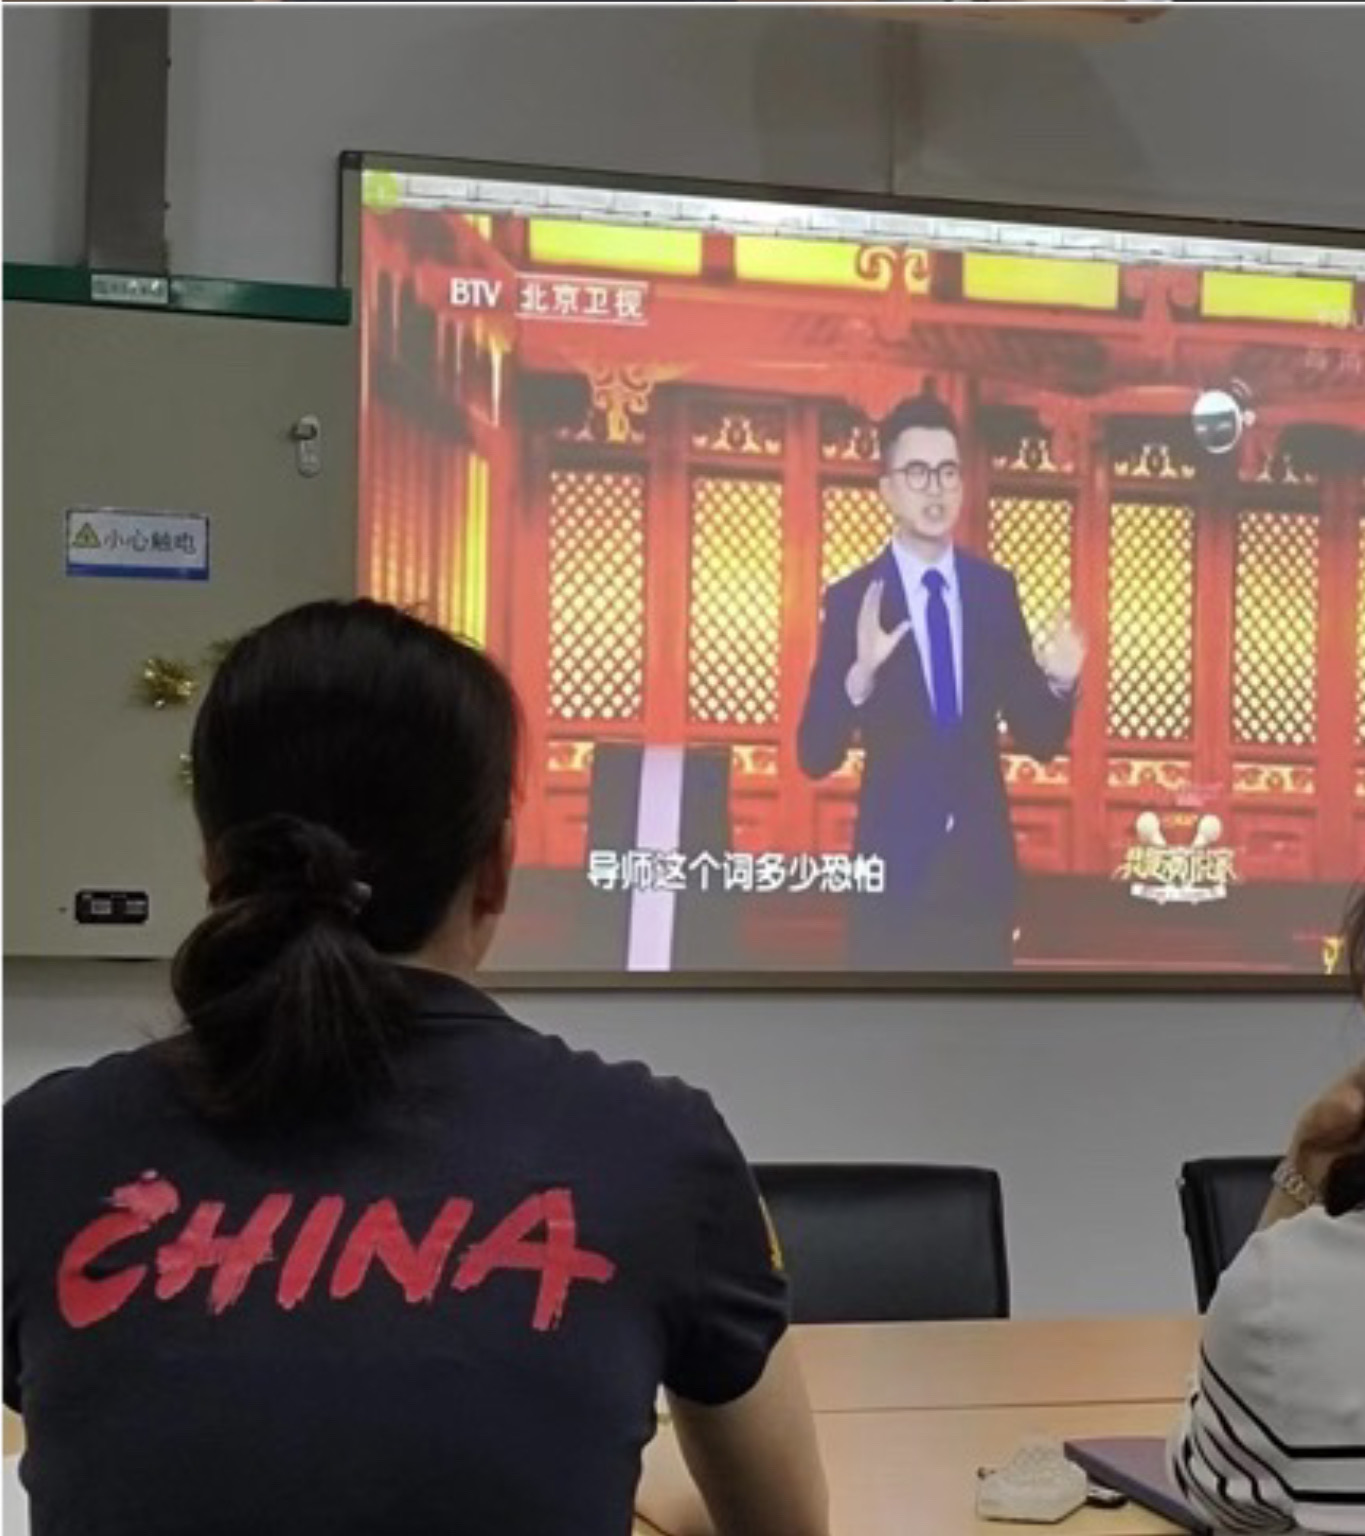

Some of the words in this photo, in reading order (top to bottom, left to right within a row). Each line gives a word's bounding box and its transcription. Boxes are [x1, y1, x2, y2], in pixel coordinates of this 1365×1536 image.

[451, 277, 503, 308] BTV
[519, 281, 644, 320] 北京卫视
[103, 528, 197, 556] 小心触电
[586, 849, 887, 894] 导师这个词多少恐怕
[57, 1170, 616, 1330] CHINA
